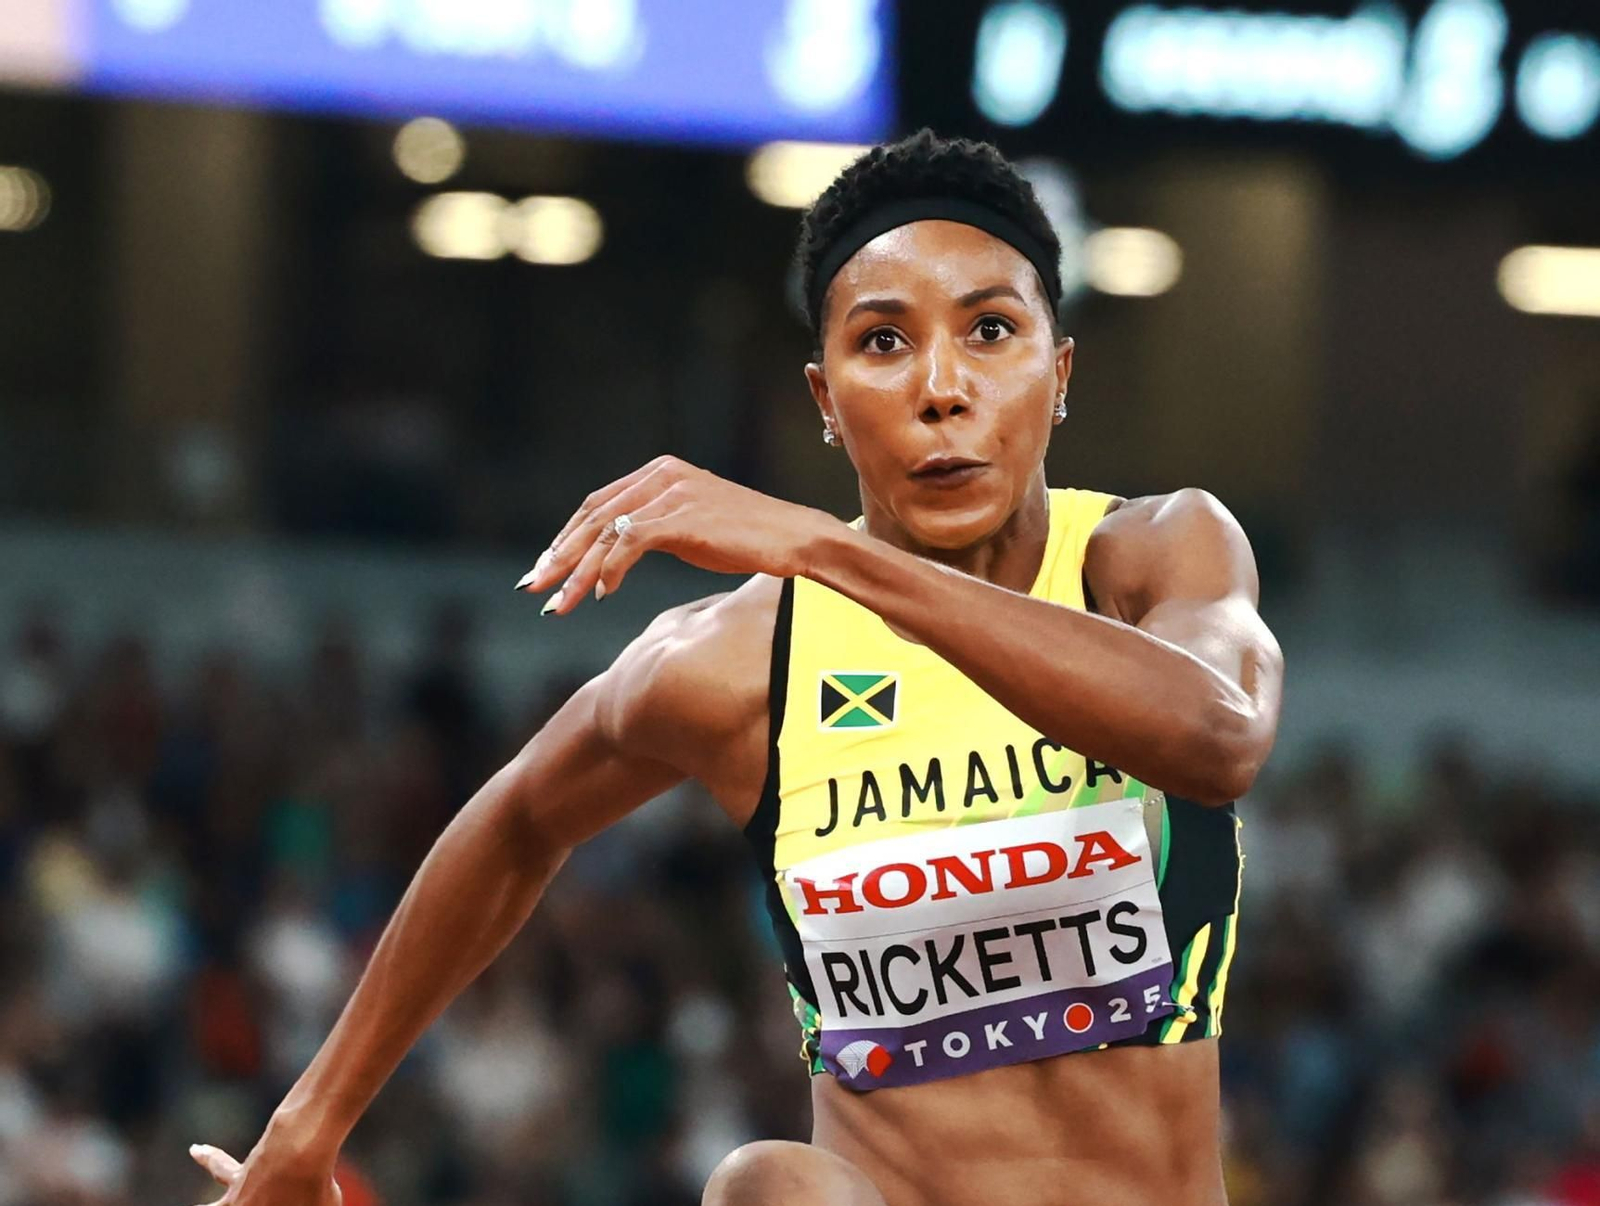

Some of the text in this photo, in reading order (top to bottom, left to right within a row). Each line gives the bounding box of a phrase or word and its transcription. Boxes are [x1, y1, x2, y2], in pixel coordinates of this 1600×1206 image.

[795, 831, 1141, 915] HONDA
[821, 901, 1147, 1017] RICKETTS
[1108, 985, 1161, 1023] 25
